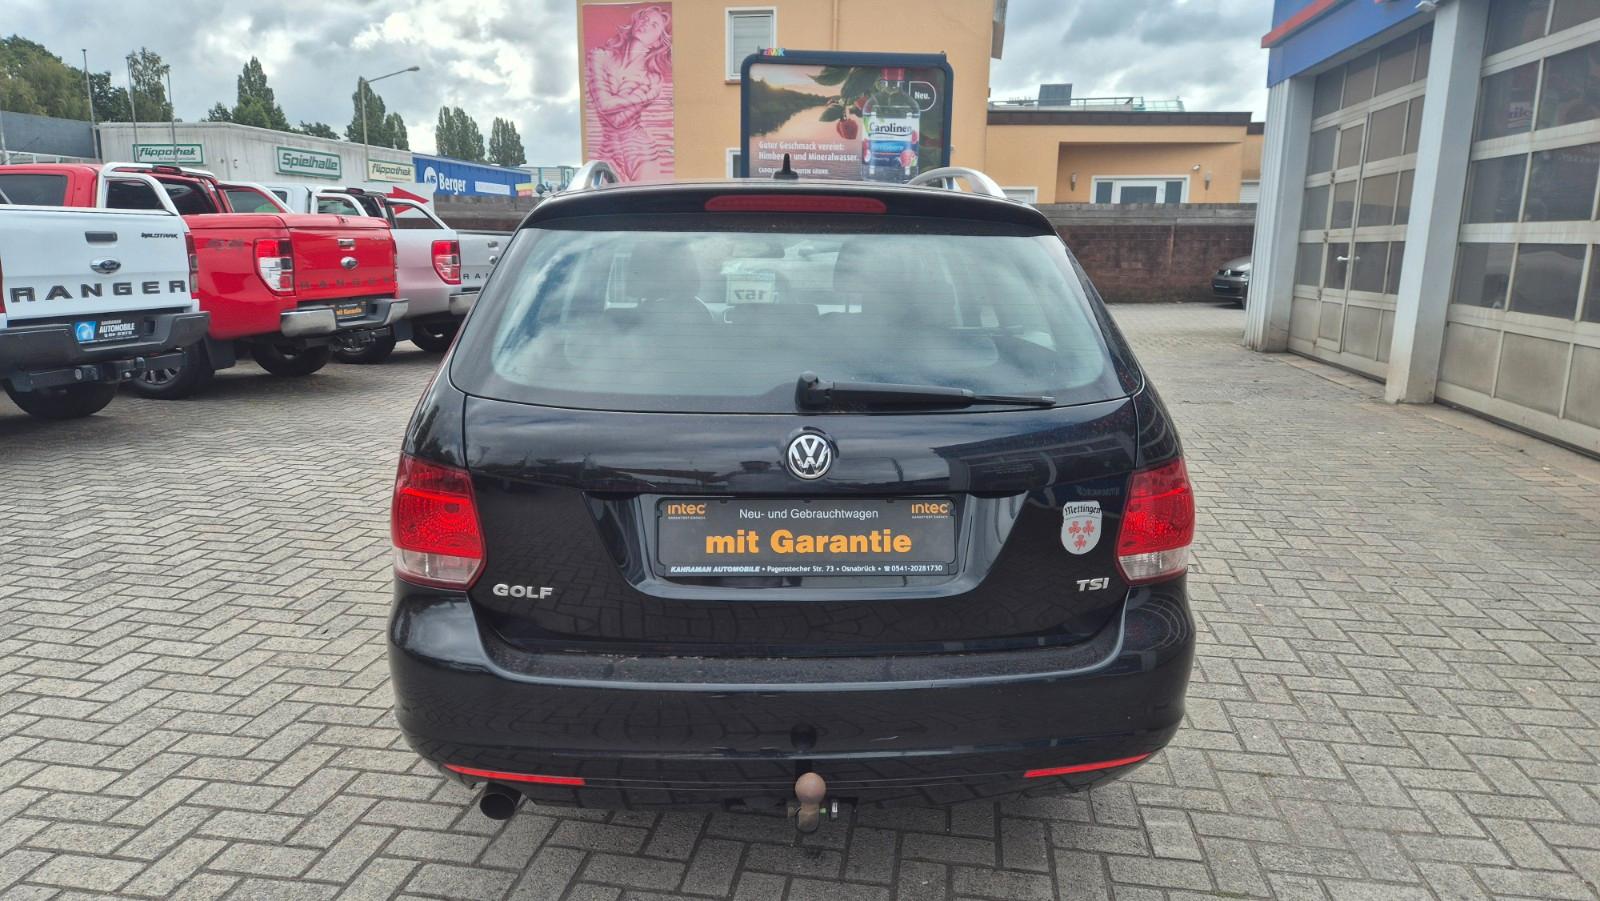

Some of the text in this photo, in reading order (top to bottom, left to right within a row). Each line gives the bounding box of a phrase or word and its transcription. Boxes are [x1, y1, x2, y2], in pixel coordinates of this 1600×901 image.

[914, 91, 931, 100] Neu.
[758, 141, 845, 151] Guter Geschmack vereint:
[282, 153, 338, 170] Spielhalle
[793, 152, 807, 161] und
[808, 152, 860, 162] Mineralwasser.
[438, 172, 467, 195] Berger
[9, 280, 187, 303] RANGER
[99, 322, 136, 334] AUTOMOBILE
[667, 503, 707, 515] intec
[911, 502, 949, 514] intec
[1064, 504, 1101, 516] Mettingen
[739, 508, 879, 521] Neu- und Gebrauchtwagen
[705, 528, 912, 554] mit Garantie
[766, 565, 811, 574] Pagenstecher
[841, 564, 876, 572] Osnabrück
[1076, 577, 1110, 592] TSI
[492, 583, 554, 600] GOLF
